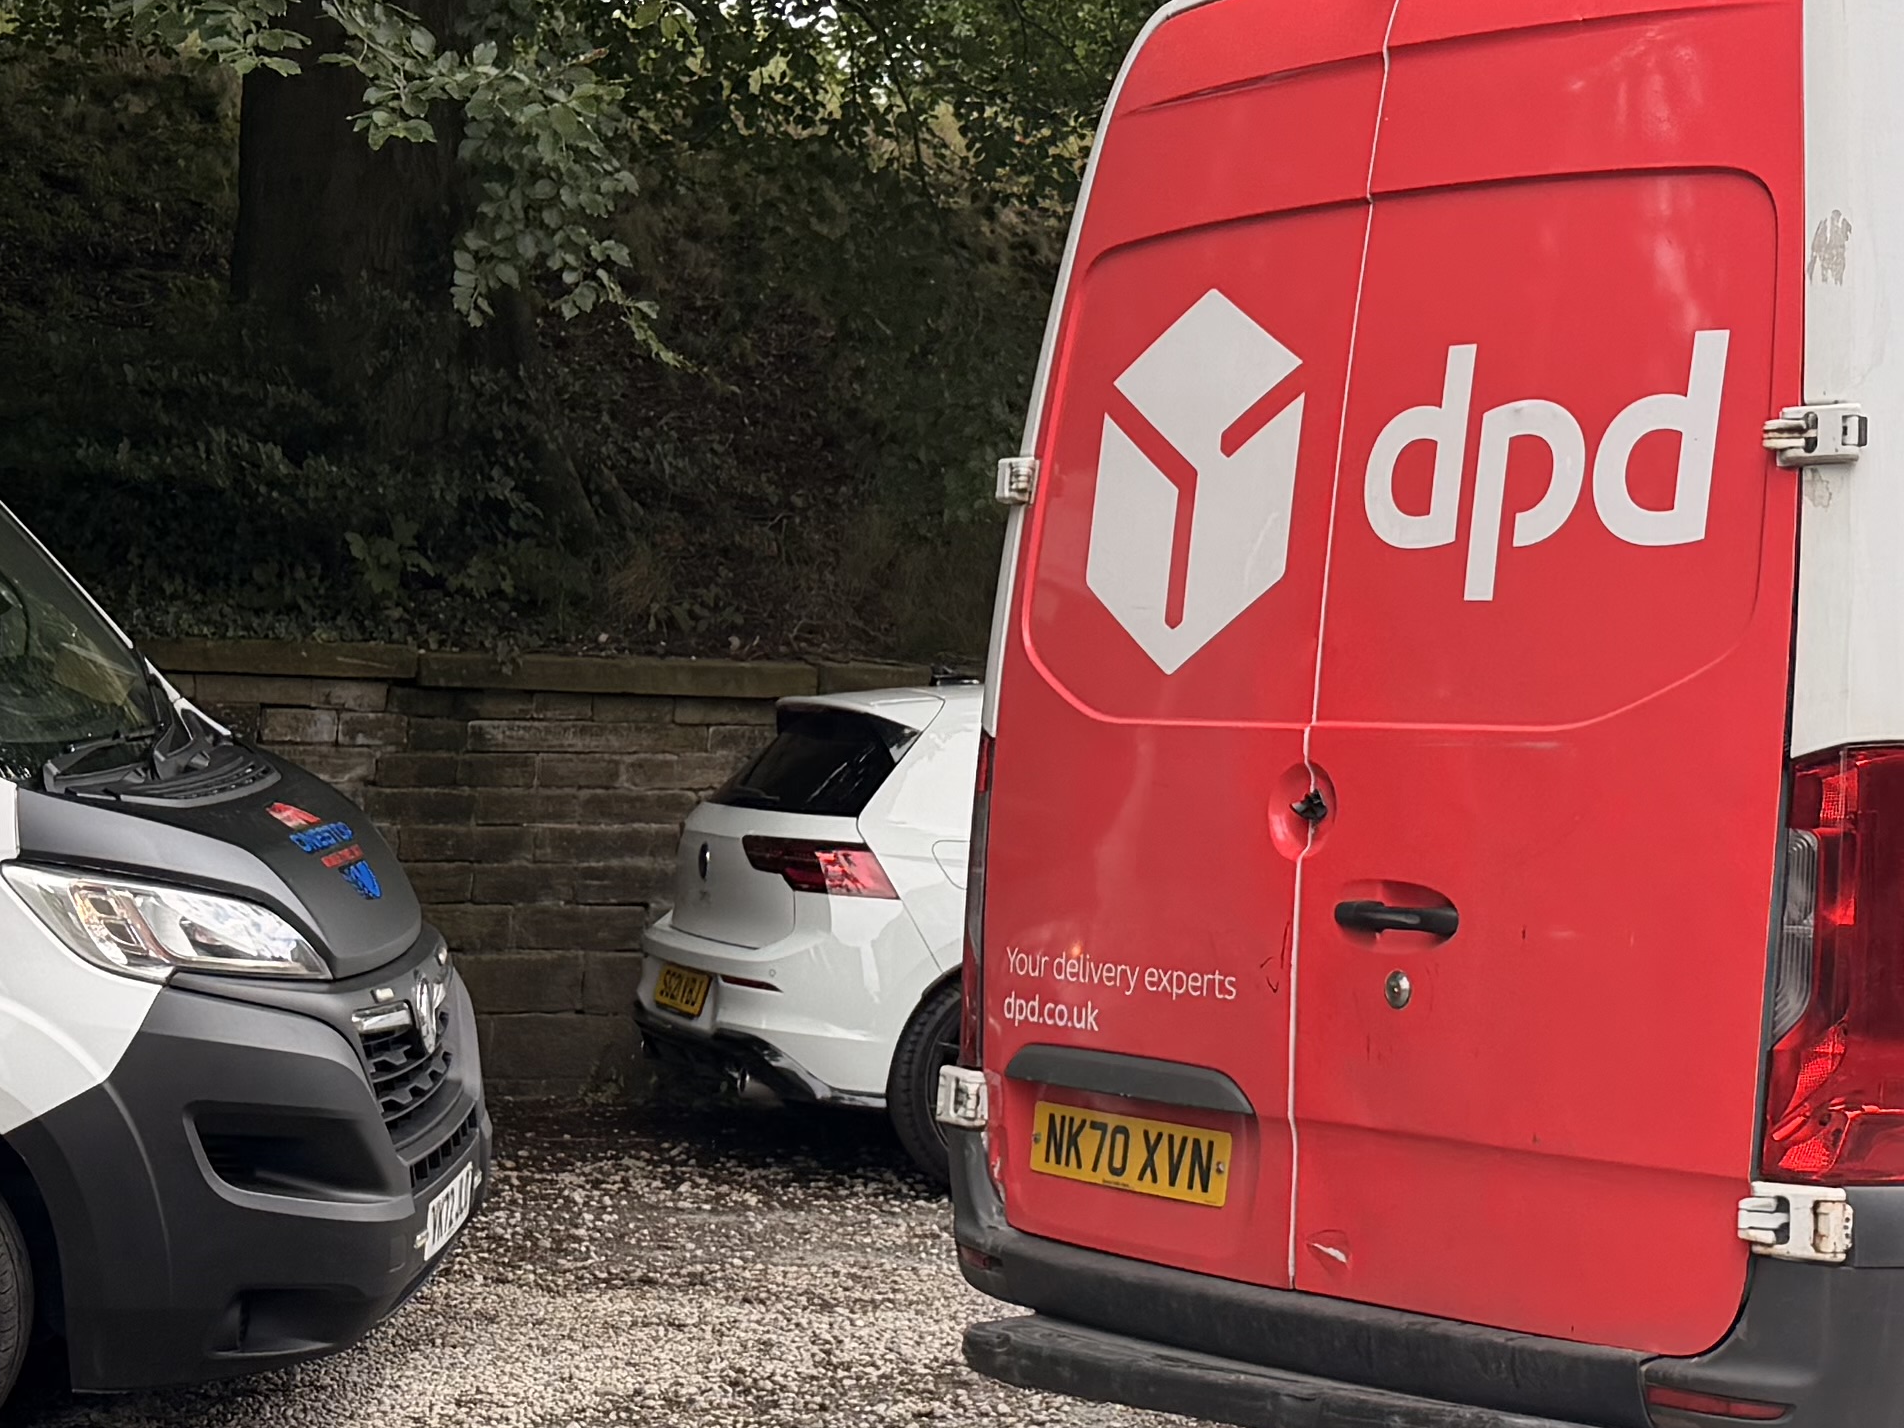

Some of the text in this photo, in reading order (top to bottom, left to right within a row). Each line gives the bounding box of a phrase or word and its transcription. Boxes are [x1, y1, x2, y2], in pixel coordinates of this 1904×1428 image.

[1364, 330, 1730, 601] dpd
[1006, 946, 1238, 1000] Your delivery experts
[1003, 990, 1099, 1032] dpd.co.uk
[1044, 1112, 1214, 1194] NK70 XVN
